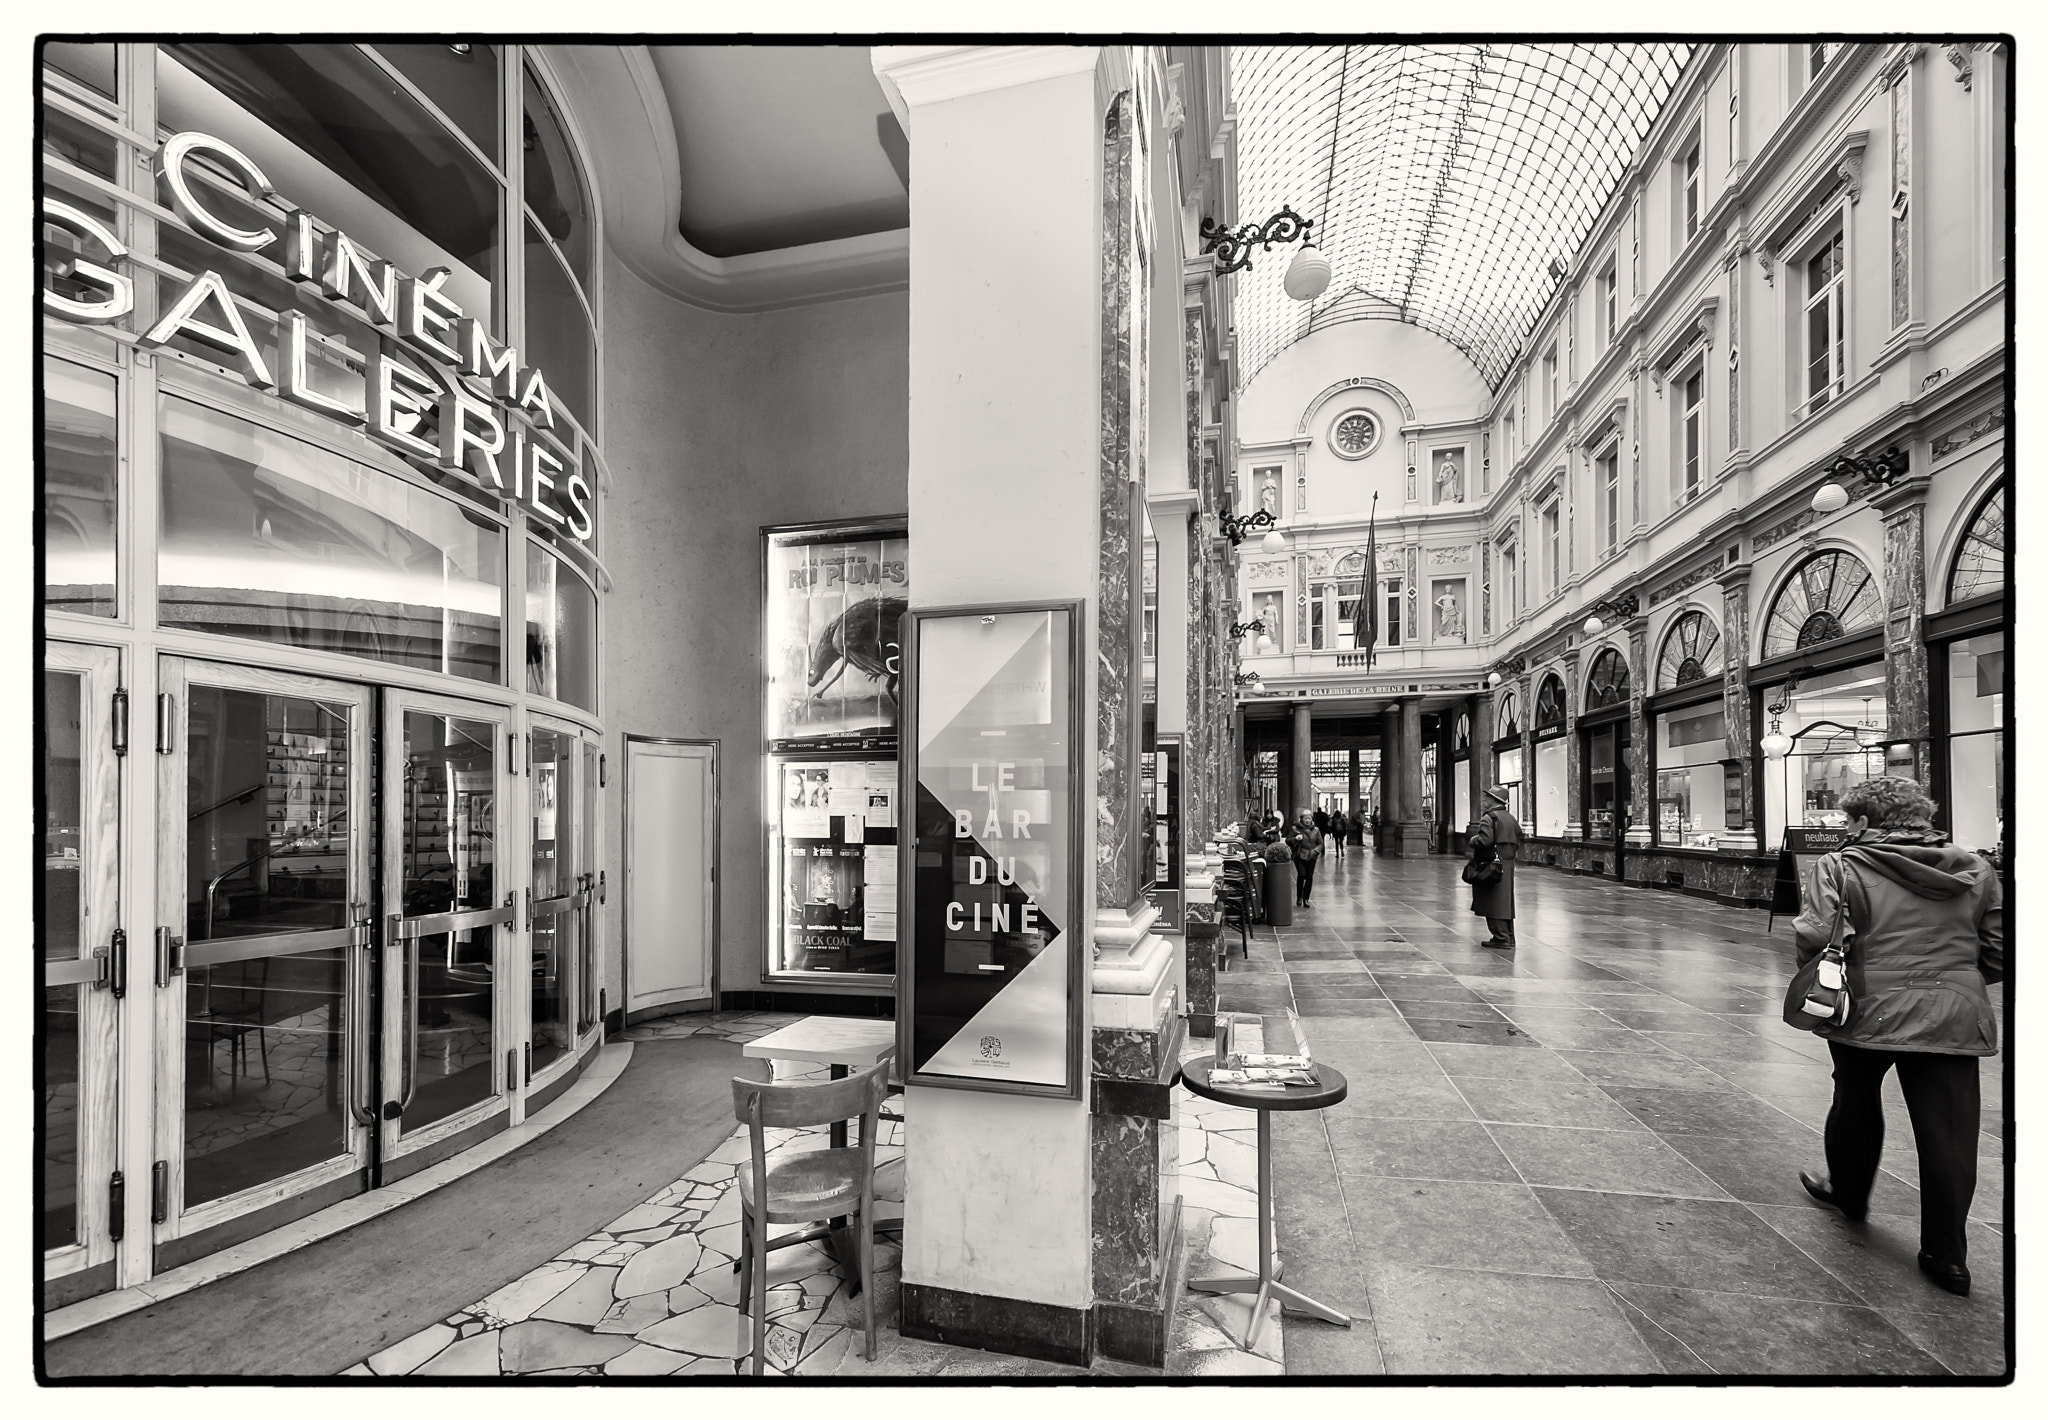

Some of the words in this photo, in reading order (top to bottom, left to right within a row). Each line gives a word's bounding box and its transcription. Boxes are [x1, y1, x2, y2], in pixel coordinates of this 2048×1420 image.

[154, 131, 555, 429] CINÉMA
[43, 197, 593, 541] GALERIES
[788, 567, 818, 589] ROI
[826, 560, 905, 587] PLUMES
[1312, 687, 1349, 696] GALERIE
[1363, 686, 1374, 694] LA
[1376, 685, 1404, 693] REINE
[972, 762, 1015, 792] LE
[955, 809, 1031, 839] BAR
[1804, 832, 1840, 843] neuhaus
[969, 855, 1016, 886] DU
[946, 895, 1039, 934] CINÉ
[794, 934, 824, 946] BLACK
[826, 935, 852, 947] COAL
